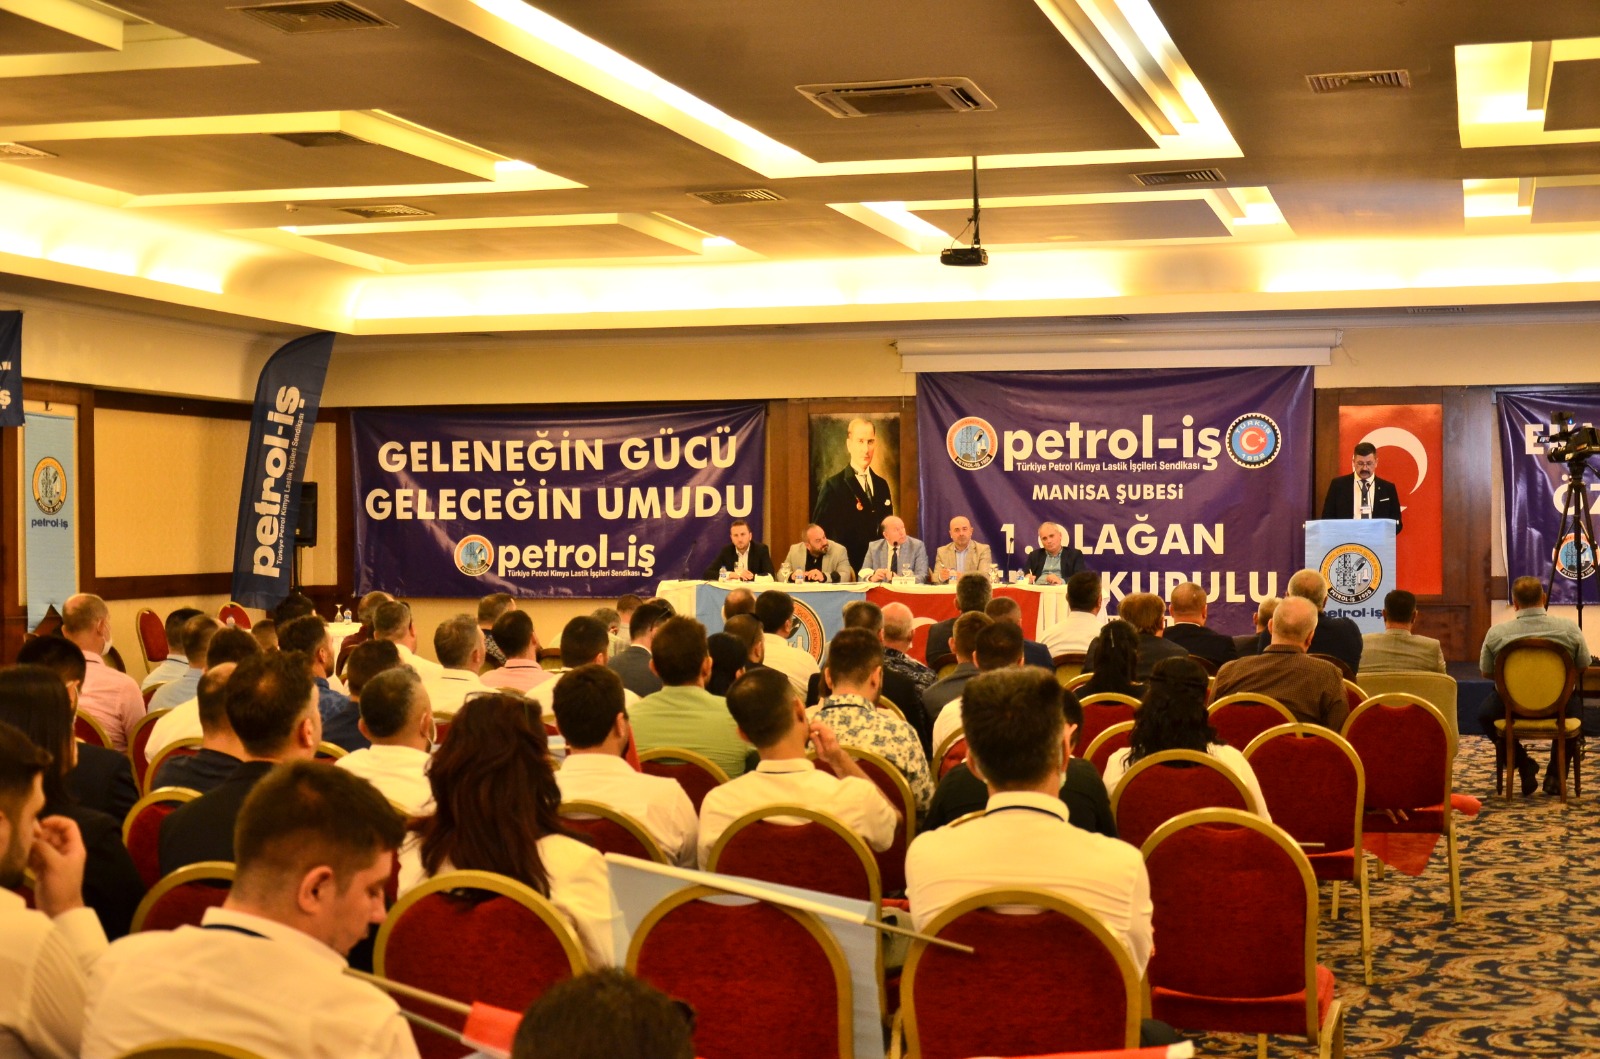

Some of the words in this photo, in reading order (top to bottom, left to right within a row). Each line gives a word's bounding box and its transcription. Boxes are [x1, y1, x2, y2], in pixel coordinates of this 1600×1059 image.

[378, 430, 604, 473] GELENEĞİN
[619, 426, 737, 469] GÜCÜ
[1003, 414, 1221, 471] petrol-iş
[1016, 462, 1046, 473] Türkiye
[1049, 462, 1073, 471] Petrol
[1074, 462, 1100, 473] Kimya
[1102, 462, 1127, 471] Lastik
[1129, 460, 1157, 472] İşçileri
[1159, 461, 1200, 470] Sendikası
[253, 386, 305, 577] petrol-iş
[284, 471, 293, 493] Lastik
[281, 494, 290, 516] Kimya
[365, 479, 581, 521] GELECEĞİN
[598, 485, 753, 520] UMUDU
[31, 518, 68, 531] petrol-iş
[276, 540, 284, 564] Türkiye
[498, 534, 655, 577] petrol-iş
[508, 570, 530, 578] Türkiye
[550, 570, 569, 578] Kimya
